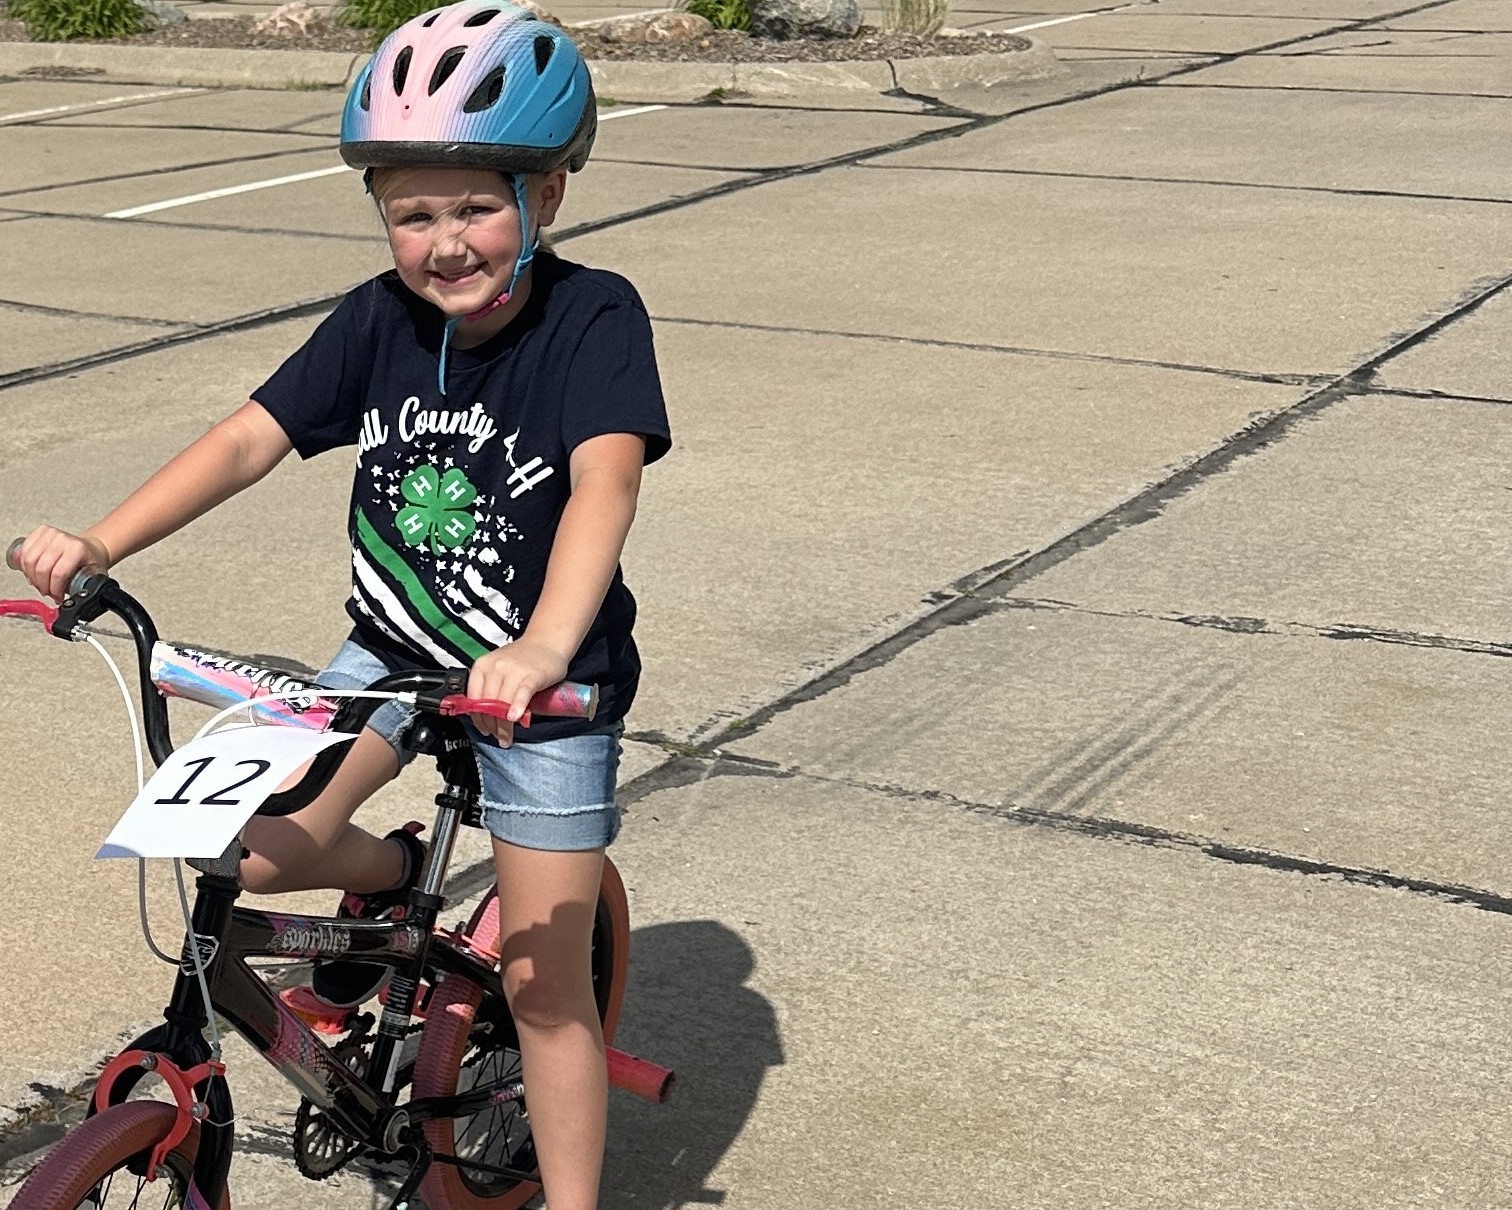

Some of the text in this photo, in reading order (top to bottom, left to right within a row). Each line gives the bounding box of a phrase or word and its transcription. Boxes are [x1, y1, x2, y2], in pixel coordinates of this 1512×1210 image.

[356, 408, 389, 468] all
[398, 396, 498, 453] County
[411, 475, 466, 502] H H
[403, 513, 466, 538] H H
[153, 756, 271, 805] 12
